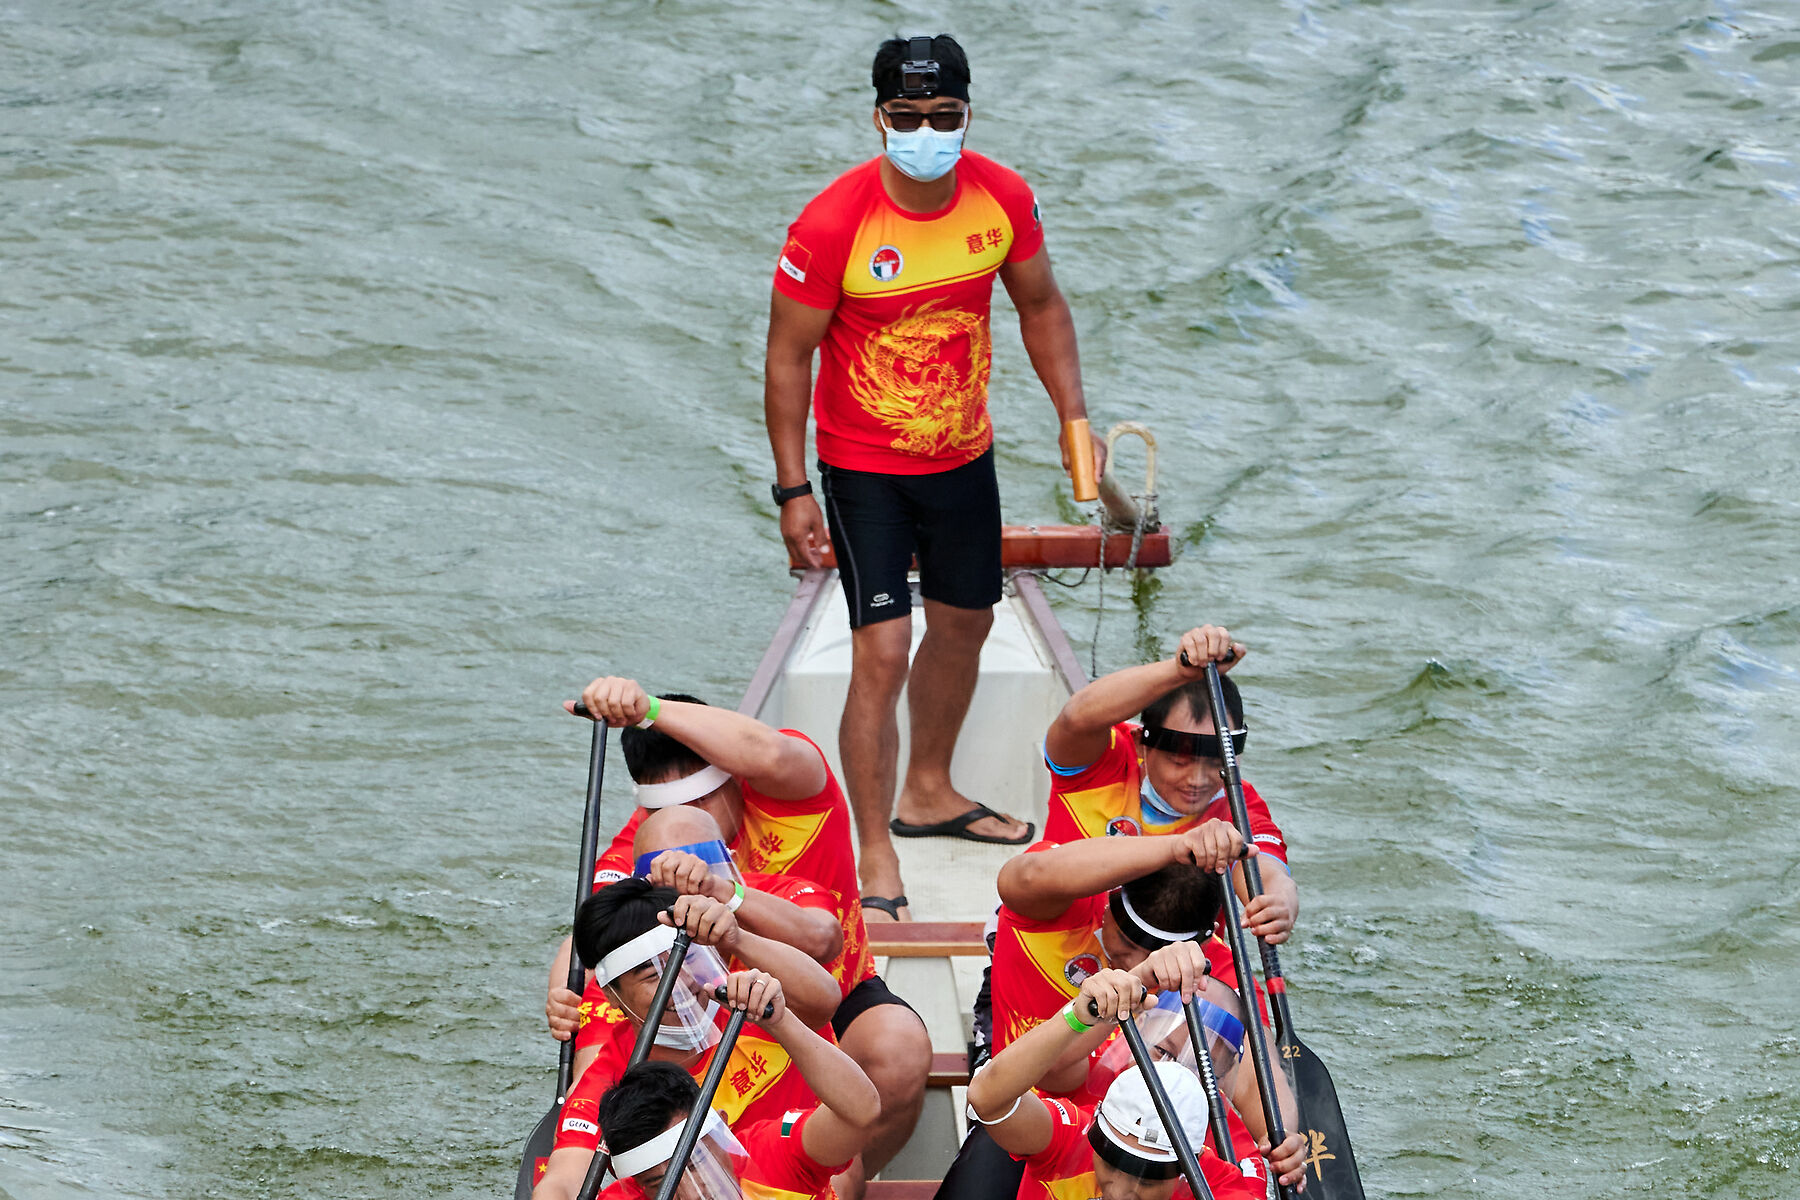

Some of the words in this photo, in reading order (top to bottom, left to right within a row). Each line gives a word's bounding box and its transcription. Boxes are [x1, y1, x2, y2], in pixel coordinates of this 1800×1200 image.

[965, 227, 1003, 255] 意华
[1281, 1045, 1301, 1058] 22
[729, 1050, 768, 1098] 意华
